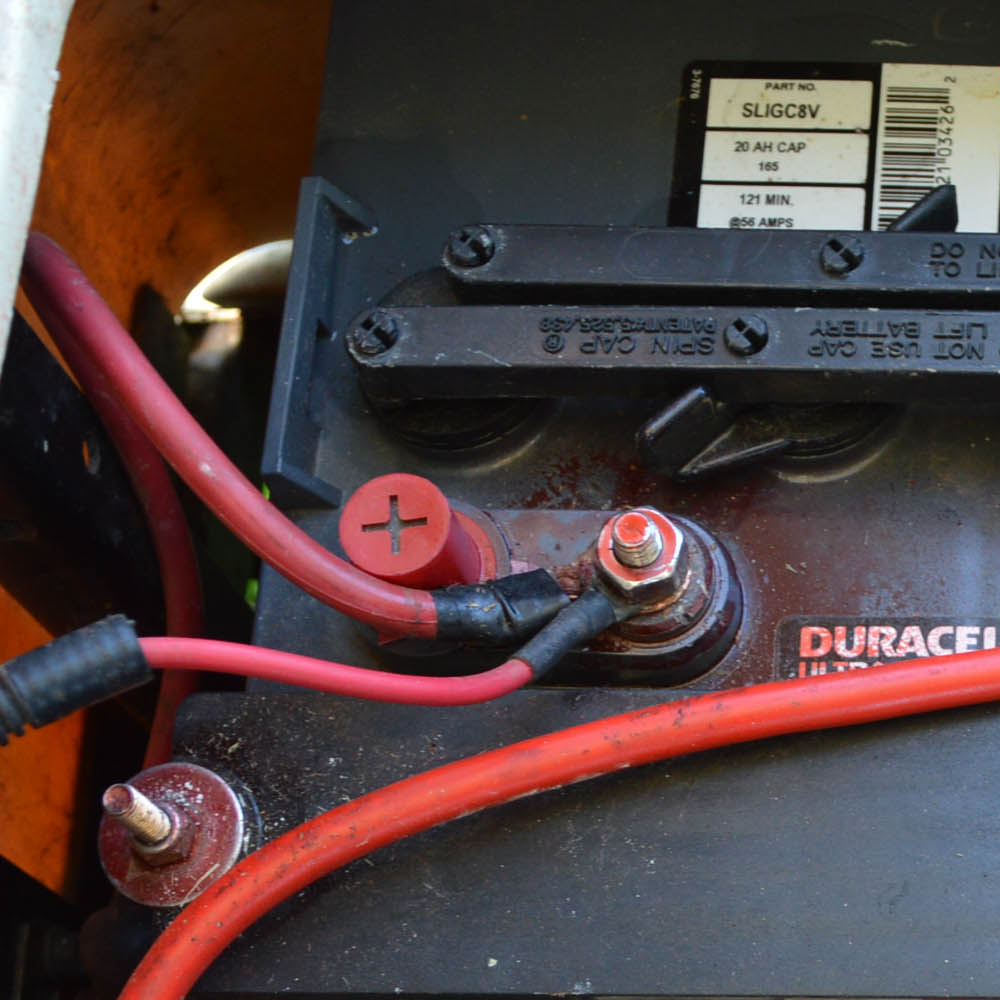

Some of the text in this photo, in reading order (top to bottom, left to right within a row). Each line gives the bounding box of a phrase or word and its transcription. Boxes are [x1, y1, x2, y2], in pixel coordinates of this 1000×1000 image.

[765, 82, 816, 91] PART NO.
[742, 103, 820, 118] SLIGC8V
[937, 105, 955, 157] 03426
[735, 141, 806, 153] 20 AH CAP
[758, 161, 779, 172] 165
[739, 194, 794, 206] 121 MIN.
[759, 217, 794, 228] AMPS
[929, 242, 966, 260] DO
[929, 261, 961, 279] TO
